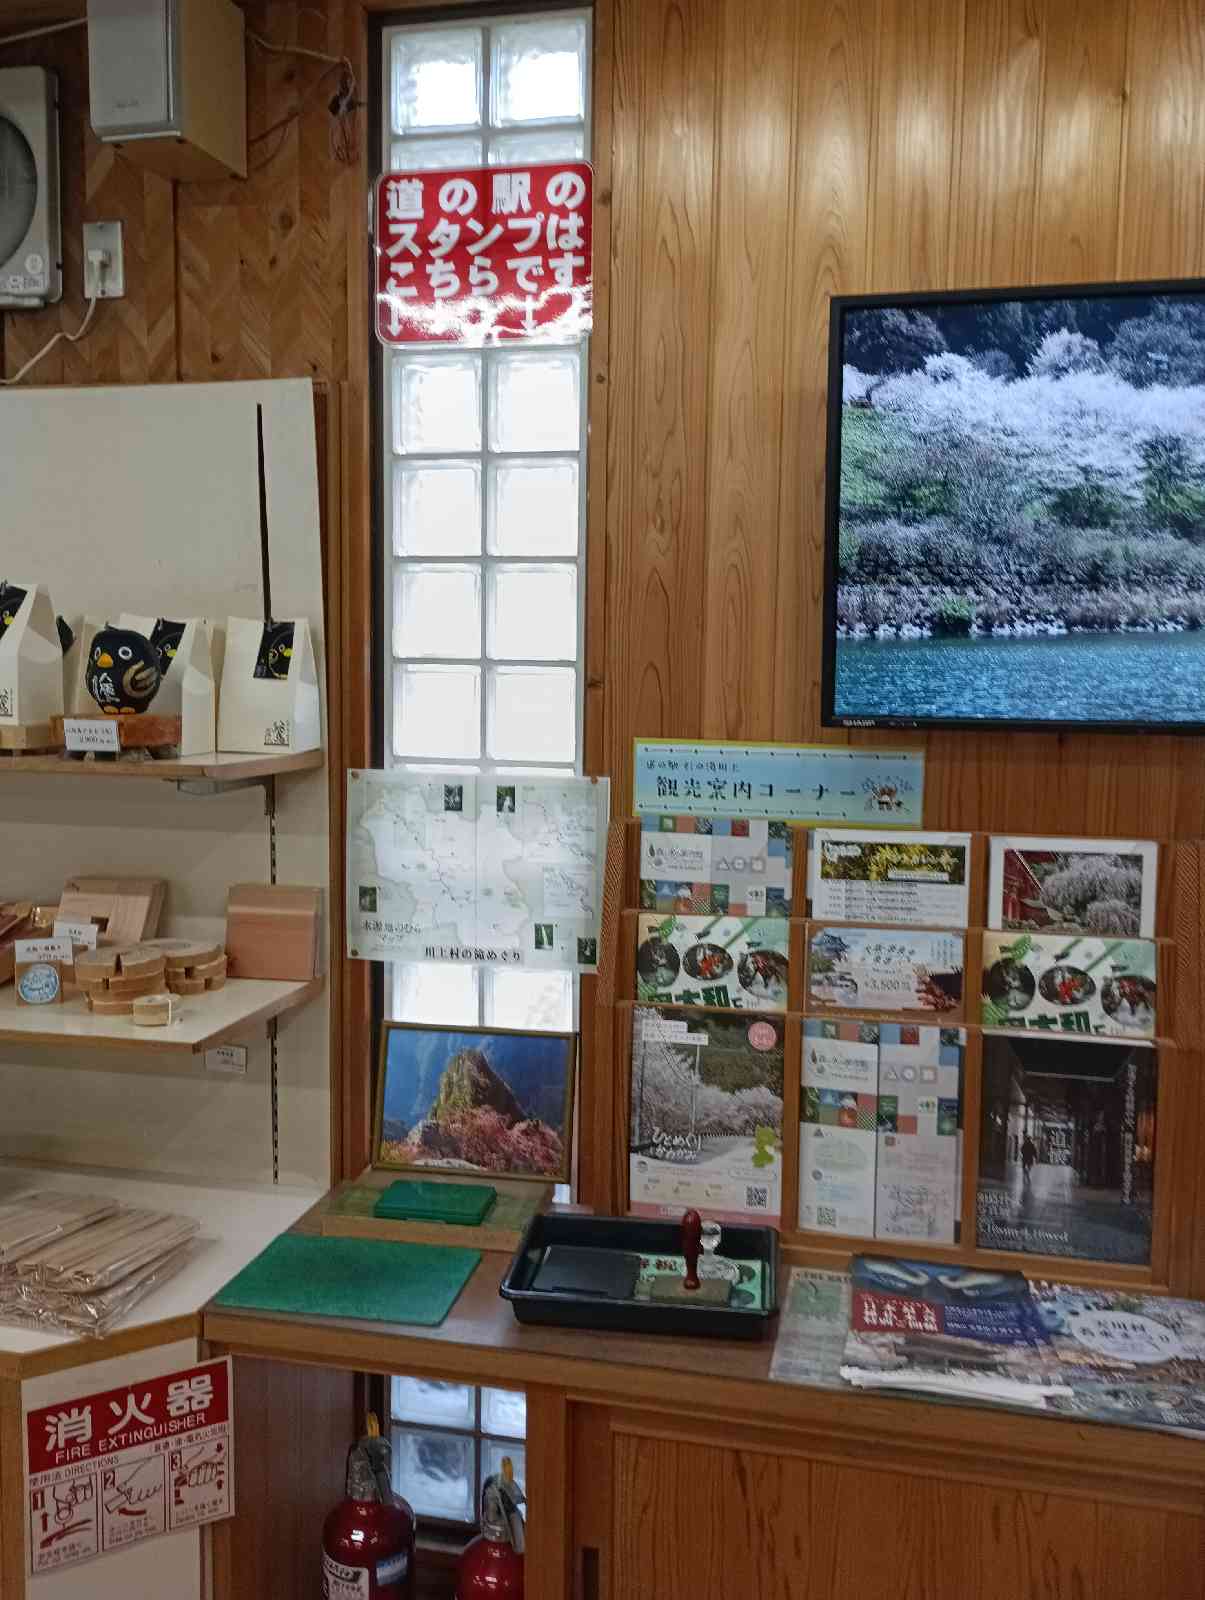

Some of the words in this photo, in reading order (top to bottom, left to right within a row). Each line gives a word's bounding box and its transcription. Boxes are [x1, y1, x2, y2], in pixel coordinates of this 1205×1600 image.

[386, 171, 586, 220] 道の駅の
[386, 212, 585, 258] スタンプは
[385, 252, 585, 297] こちらです
[656, 775, 856, 800] 観光案内コーナー
[45, 1373, 213, 1451] 消火器
[55, 1444, 91, 1464] FIRE
[99, 1415, 206, 1452] EXTINGUISHER
[64, 1455, 119, 1476] DIRECTIONS
